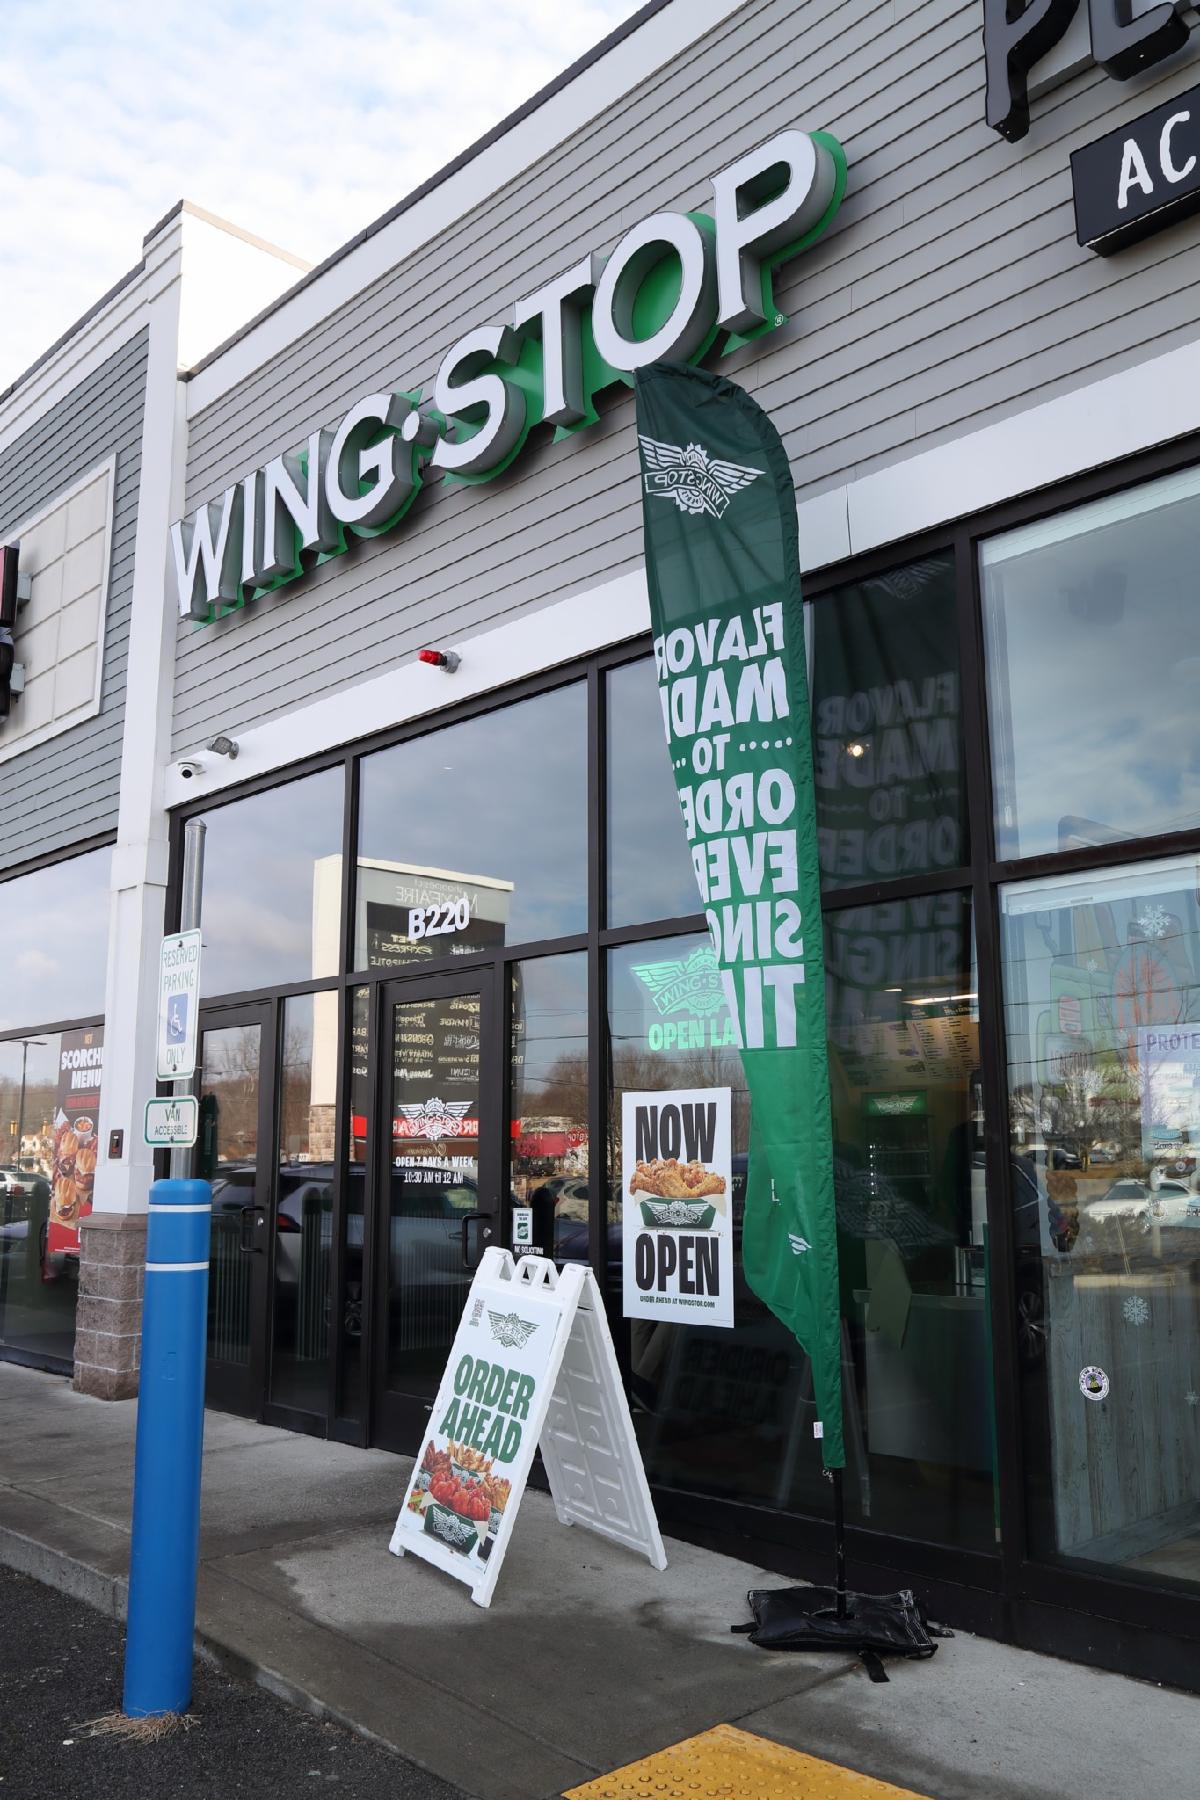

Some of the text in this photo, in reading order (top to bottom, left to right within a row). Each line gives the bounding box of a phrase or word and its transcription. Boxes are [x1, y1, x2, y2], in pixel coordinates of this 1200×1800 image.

[408, 898, 470, 941] B220
[162, 944, 198, 969] RESERVED
[163, 969, 195, 992] PARKING
[648, 1019, 705, 1051] OPEN
[166, 1047, 186, 1066] ONLY
[71, 1068, 102, 1089] MENU
[164, 1107, 181, 1122] VAN
[635, 1102, 717, 1164] NOW
[395, 1156, 415, 1167] OPEN
[422, 1156, 442, 1167] DAYS
[451, 1156, 474, 1168] WEEK
[423, 1172, 434, 1183] AM
[442, 1172, 452, 1183] 12
[453, 1172, 464, 1184] AM
[635, 1233, 720, 1296] OPEN
[454, 1354, 536, 1421] ORDER
[439, 1396, 523, 1464] AHEAD
